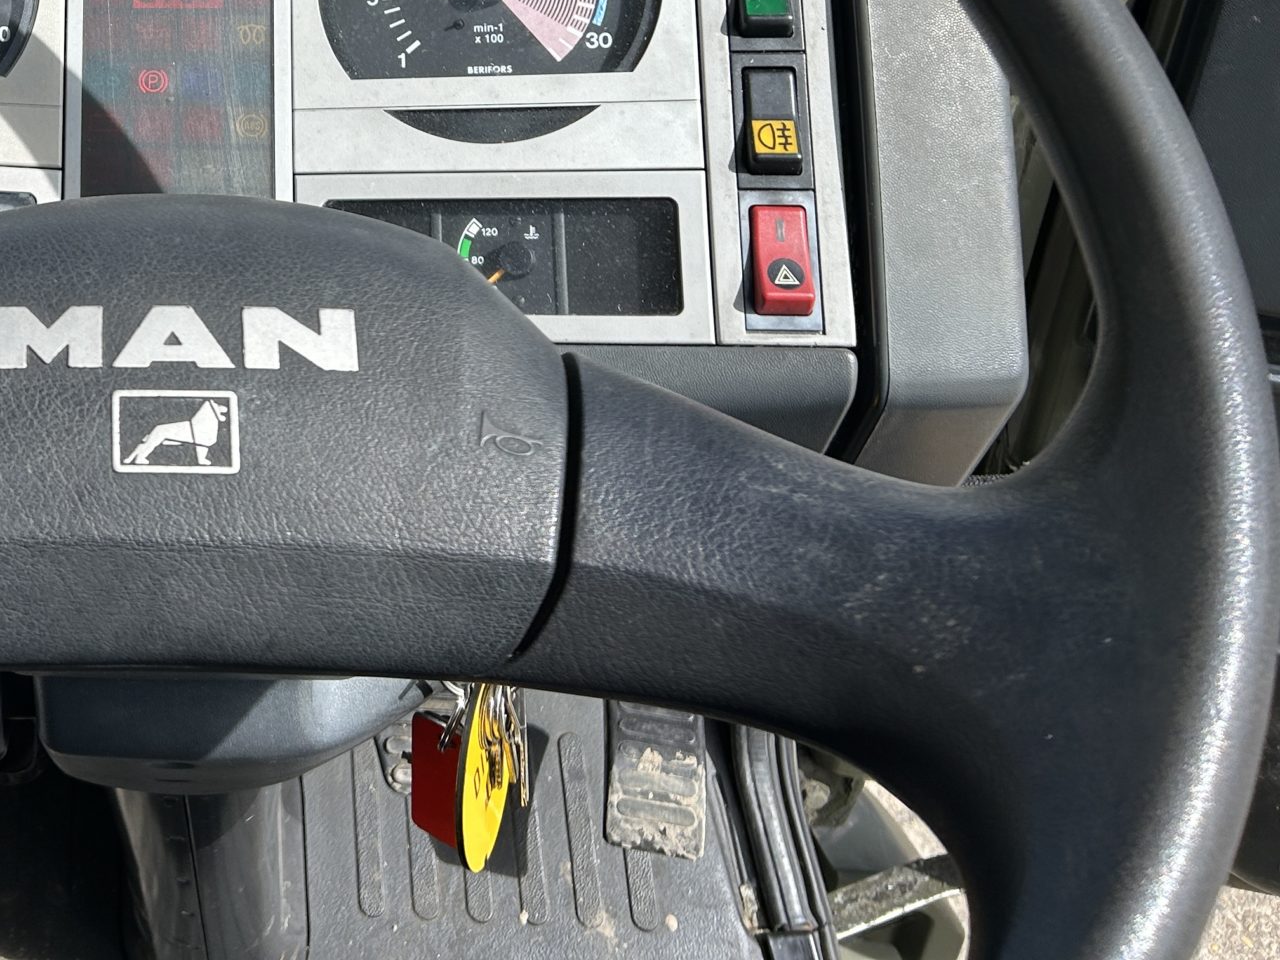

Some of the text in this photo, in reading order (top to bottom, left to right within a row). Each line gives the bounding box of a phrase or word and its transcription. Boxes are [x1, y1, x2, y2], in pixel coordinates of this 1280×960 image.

[473, 23, 504, 33] min-1
[485, 34, 504, 43] 100
[585, 32, 613, 49] 30
[398, 53, 406, 68] 1
[467, 65, 513, 74] BERIFORS
[481, 227, 498, 237] 120
[471, 255, 484, 265] 80
